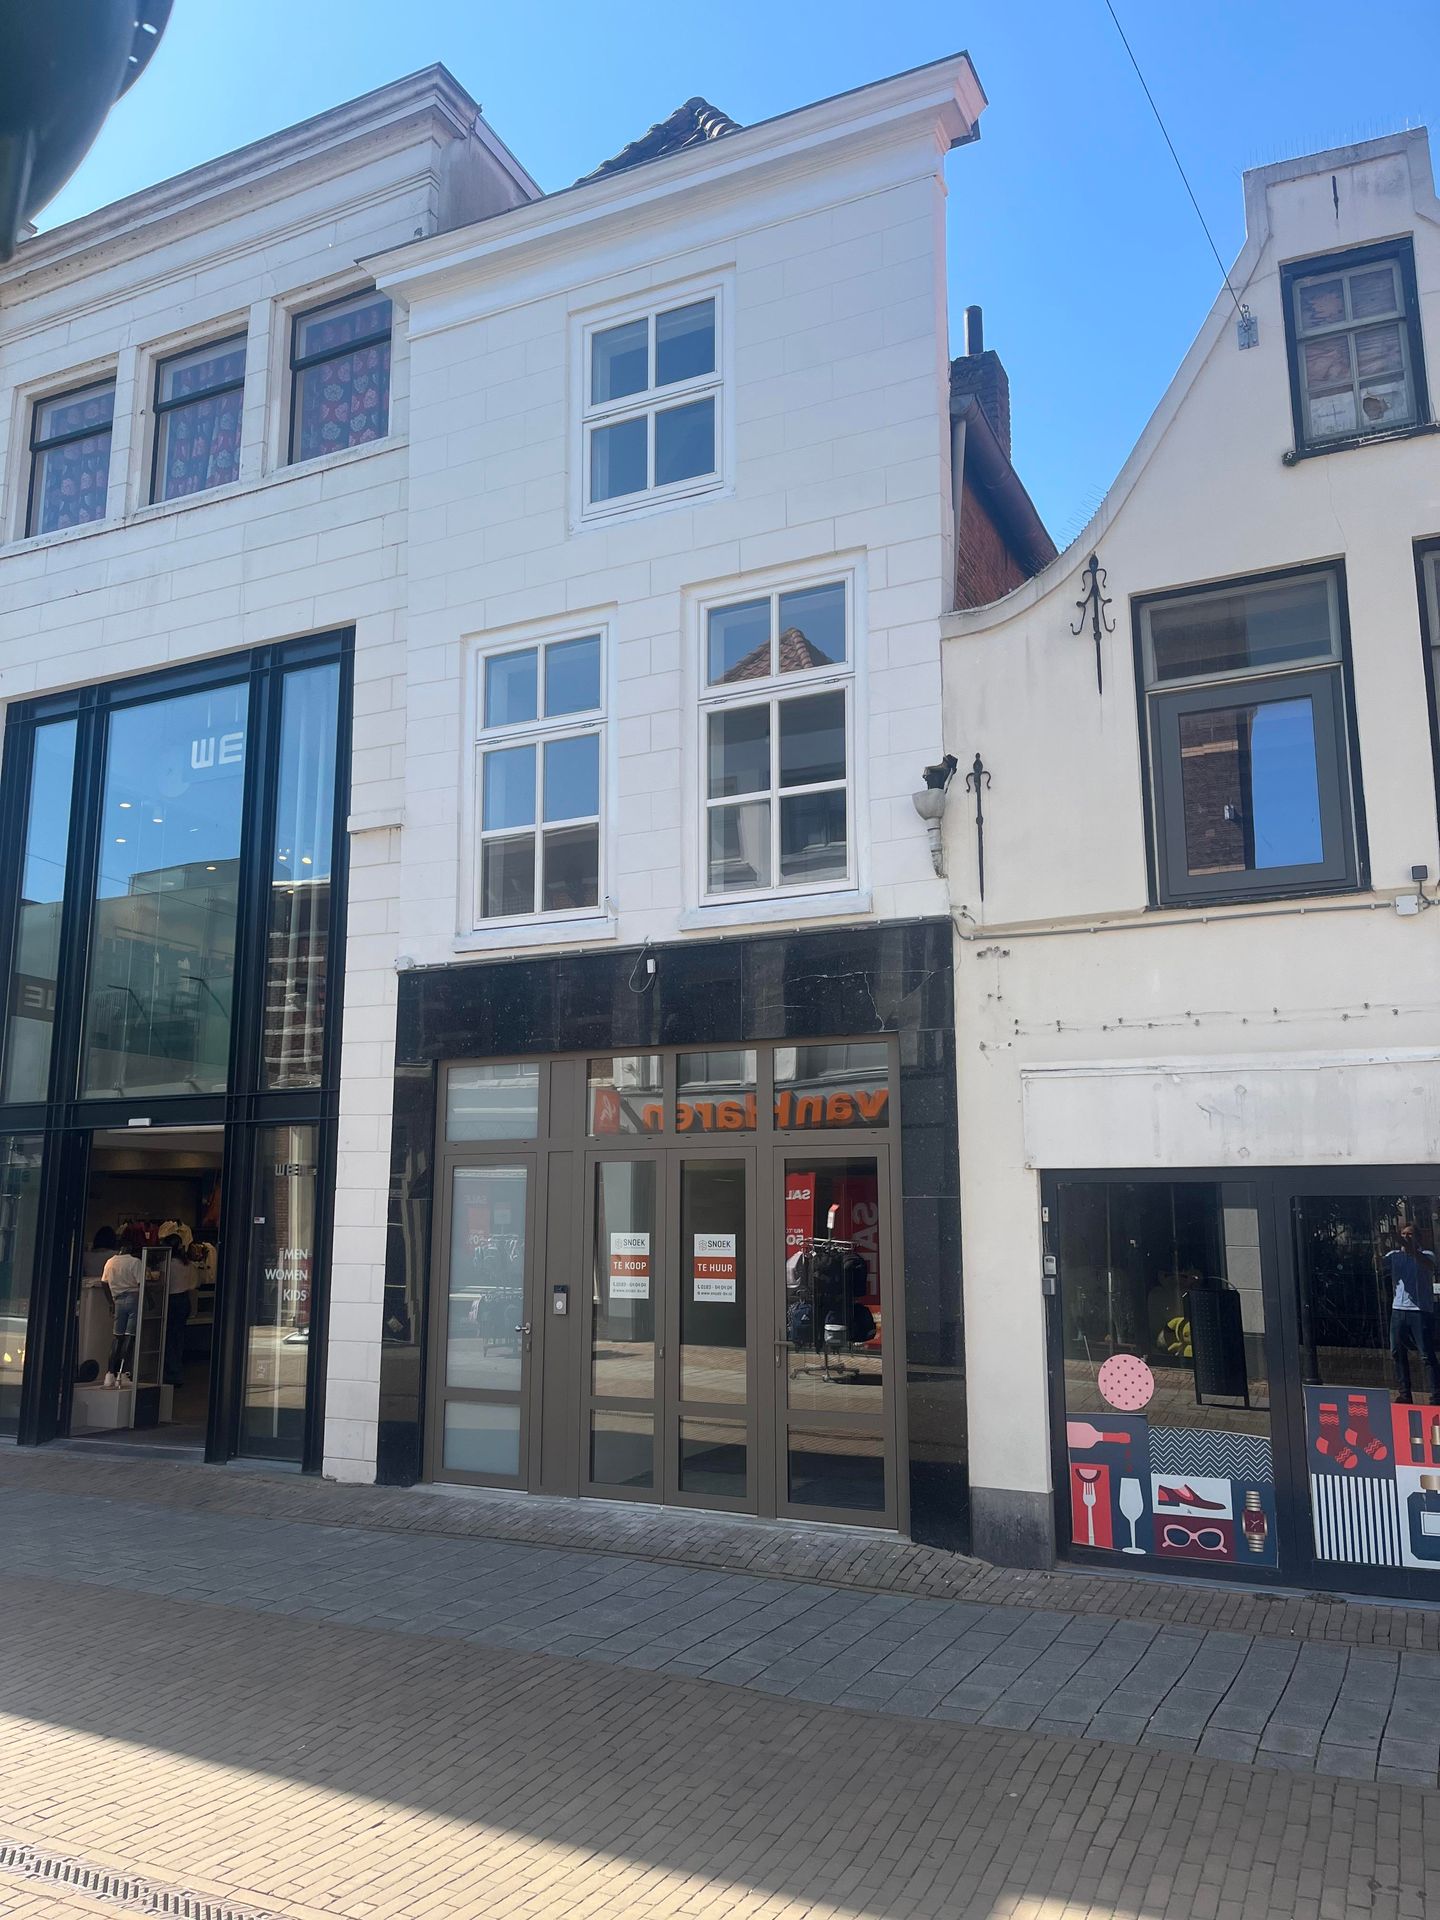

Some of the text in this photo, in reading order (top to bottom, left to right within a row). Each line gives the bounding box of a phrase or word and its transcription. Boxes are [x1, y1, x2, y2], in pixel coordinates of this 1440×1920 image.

[191, 731, 243, 769] WE
[623, 1238, 646, 1247] SNOEK
[707, 1240, 731, 1248] SNOEK
[284, 1248, 308, 1260] MEN
[613, 1261, 647, 1270] TE KOOP
[697, 1263, 733, 1273] TE HUUR
[265, 1268, 308, 1281] WOMEN
[283, 1289, 307, 1301] KIDS
